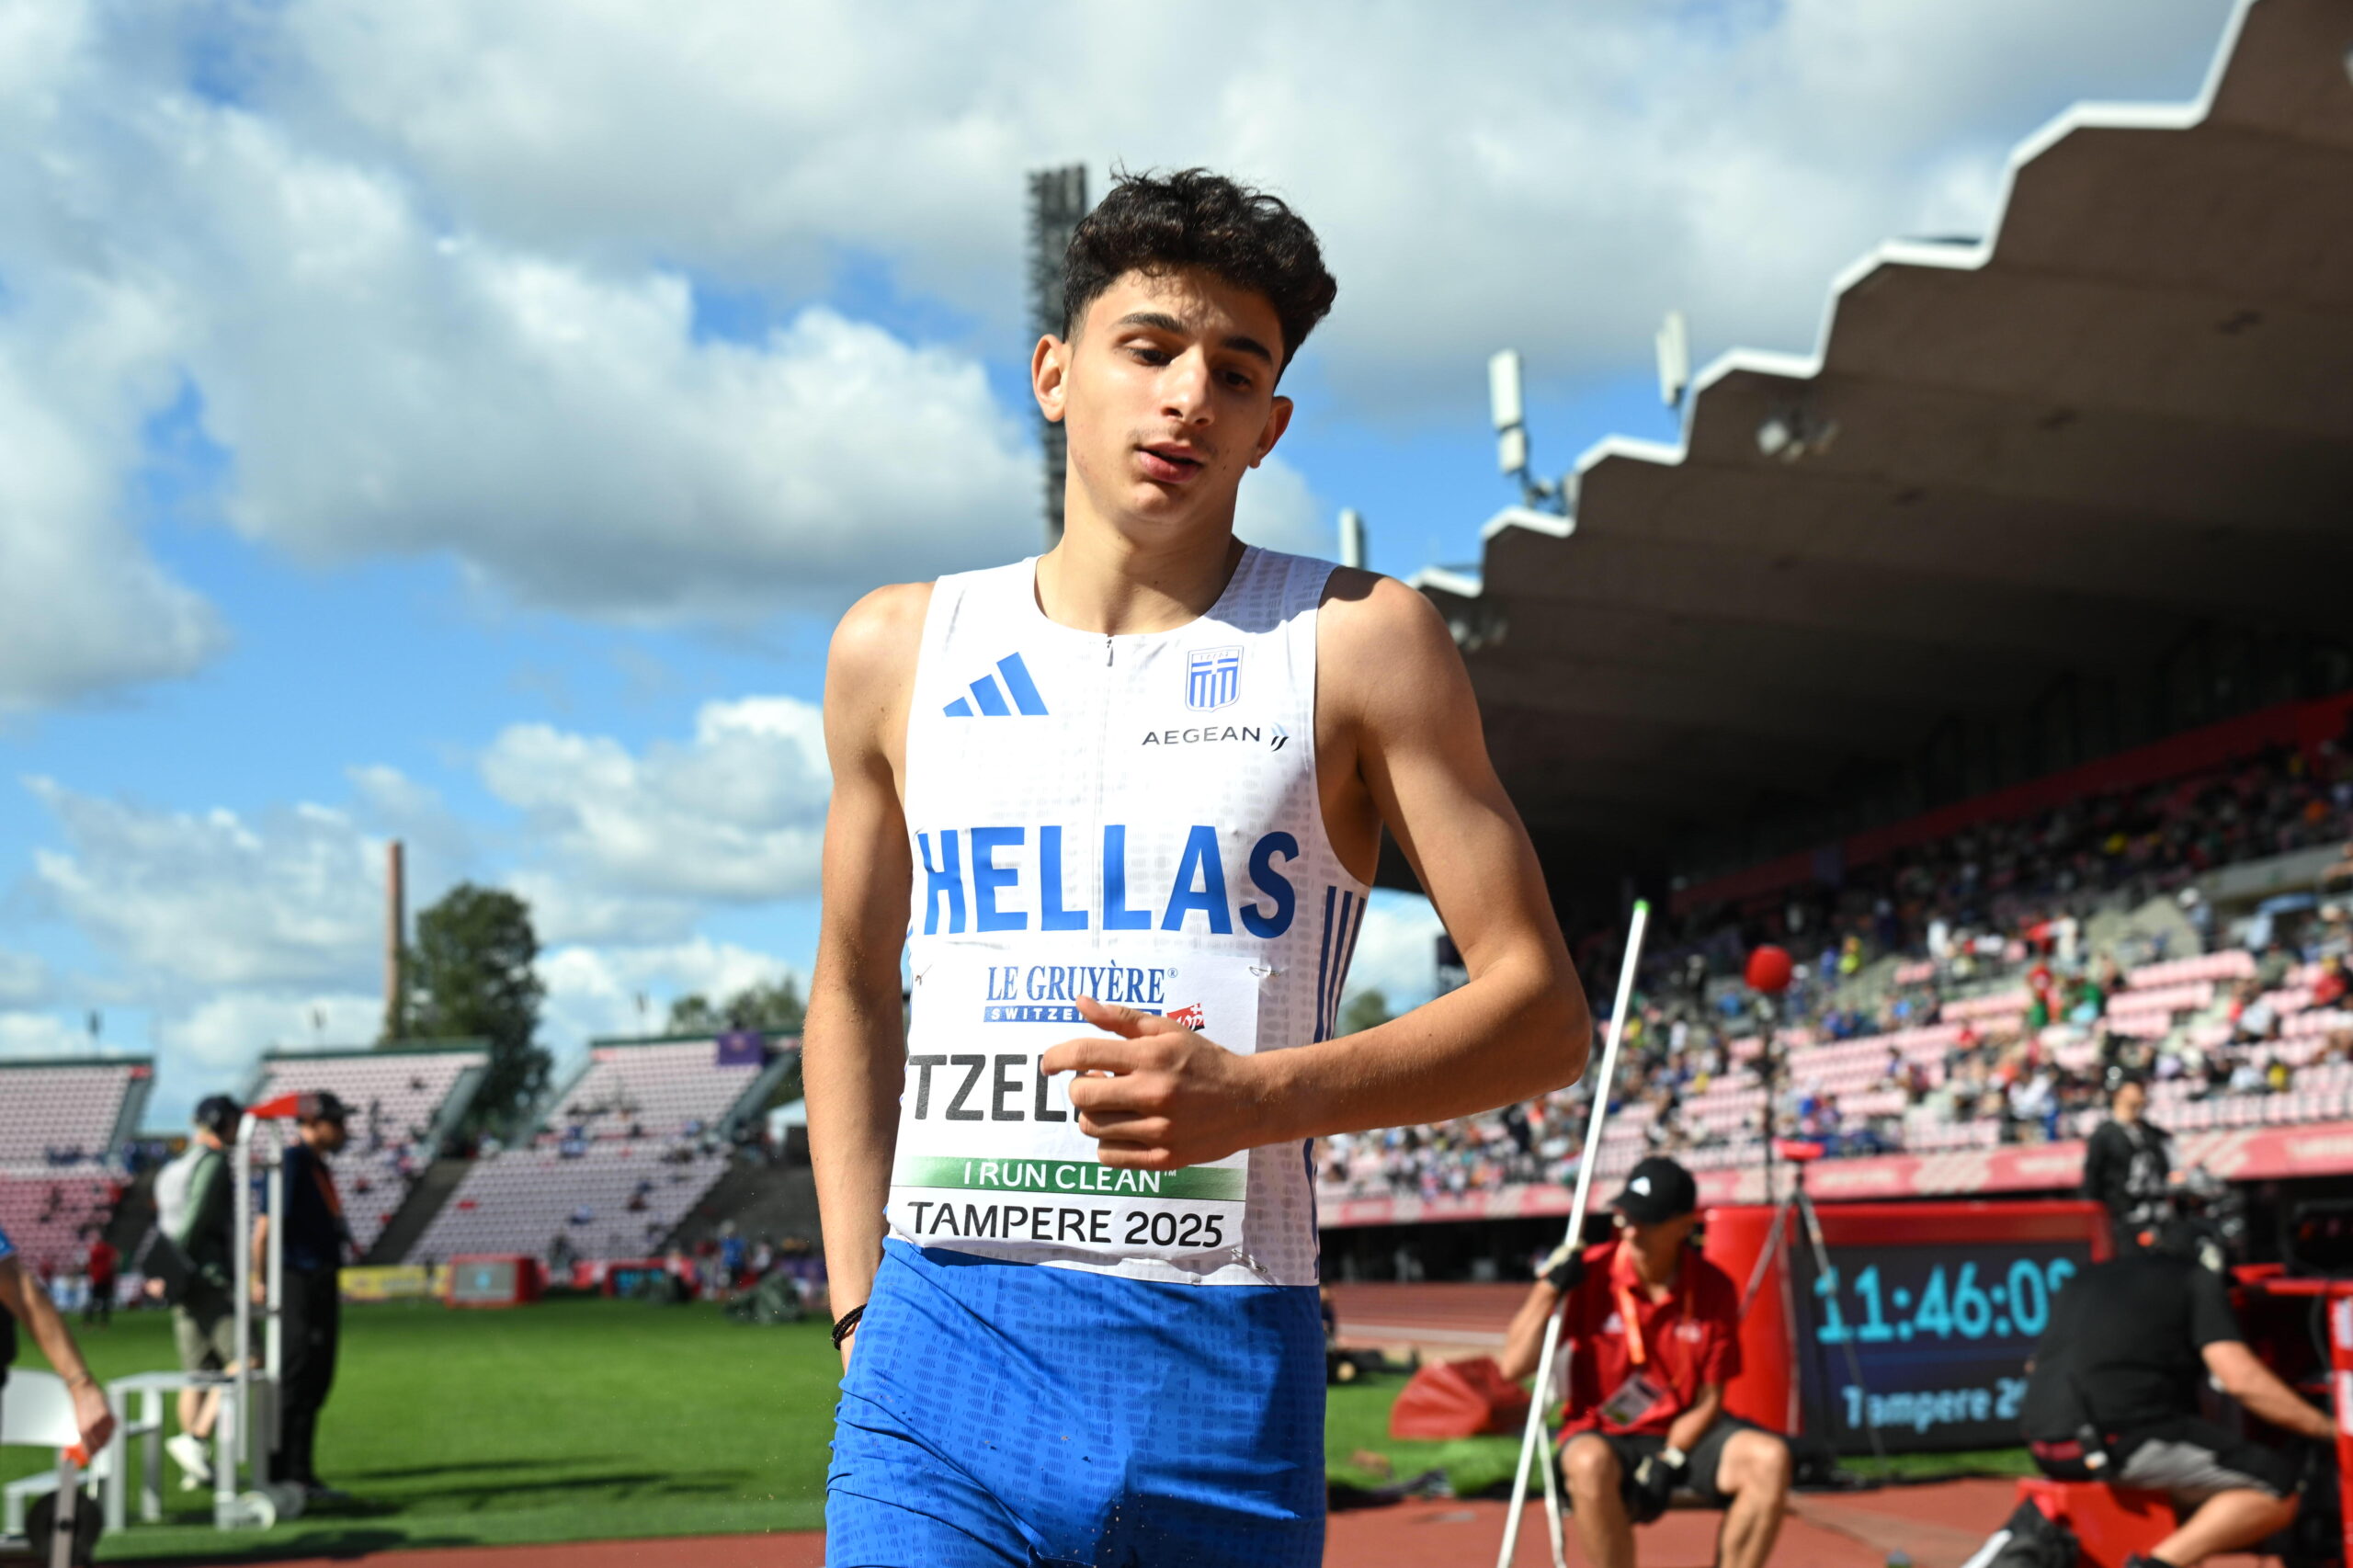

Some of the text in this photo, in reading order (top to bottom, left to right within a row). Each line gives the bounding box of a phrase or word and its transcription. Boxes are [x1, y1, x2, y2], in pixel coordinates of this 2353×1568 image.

[1142, 726, 1260, 745] AEGEAN
[917, 824, 1300, 939] HELLAS
[986, 966, 1018, 1001] LE
[908, 1053, 1089, 1123] TZEL
[964, 1162, 972, 1185] I
[979, 1163, 1047, 1188] RUN
[907, 1201, 1224, 1248] TAMPERE 2025
[1841, 1385, 1992, 1434] Tampere
